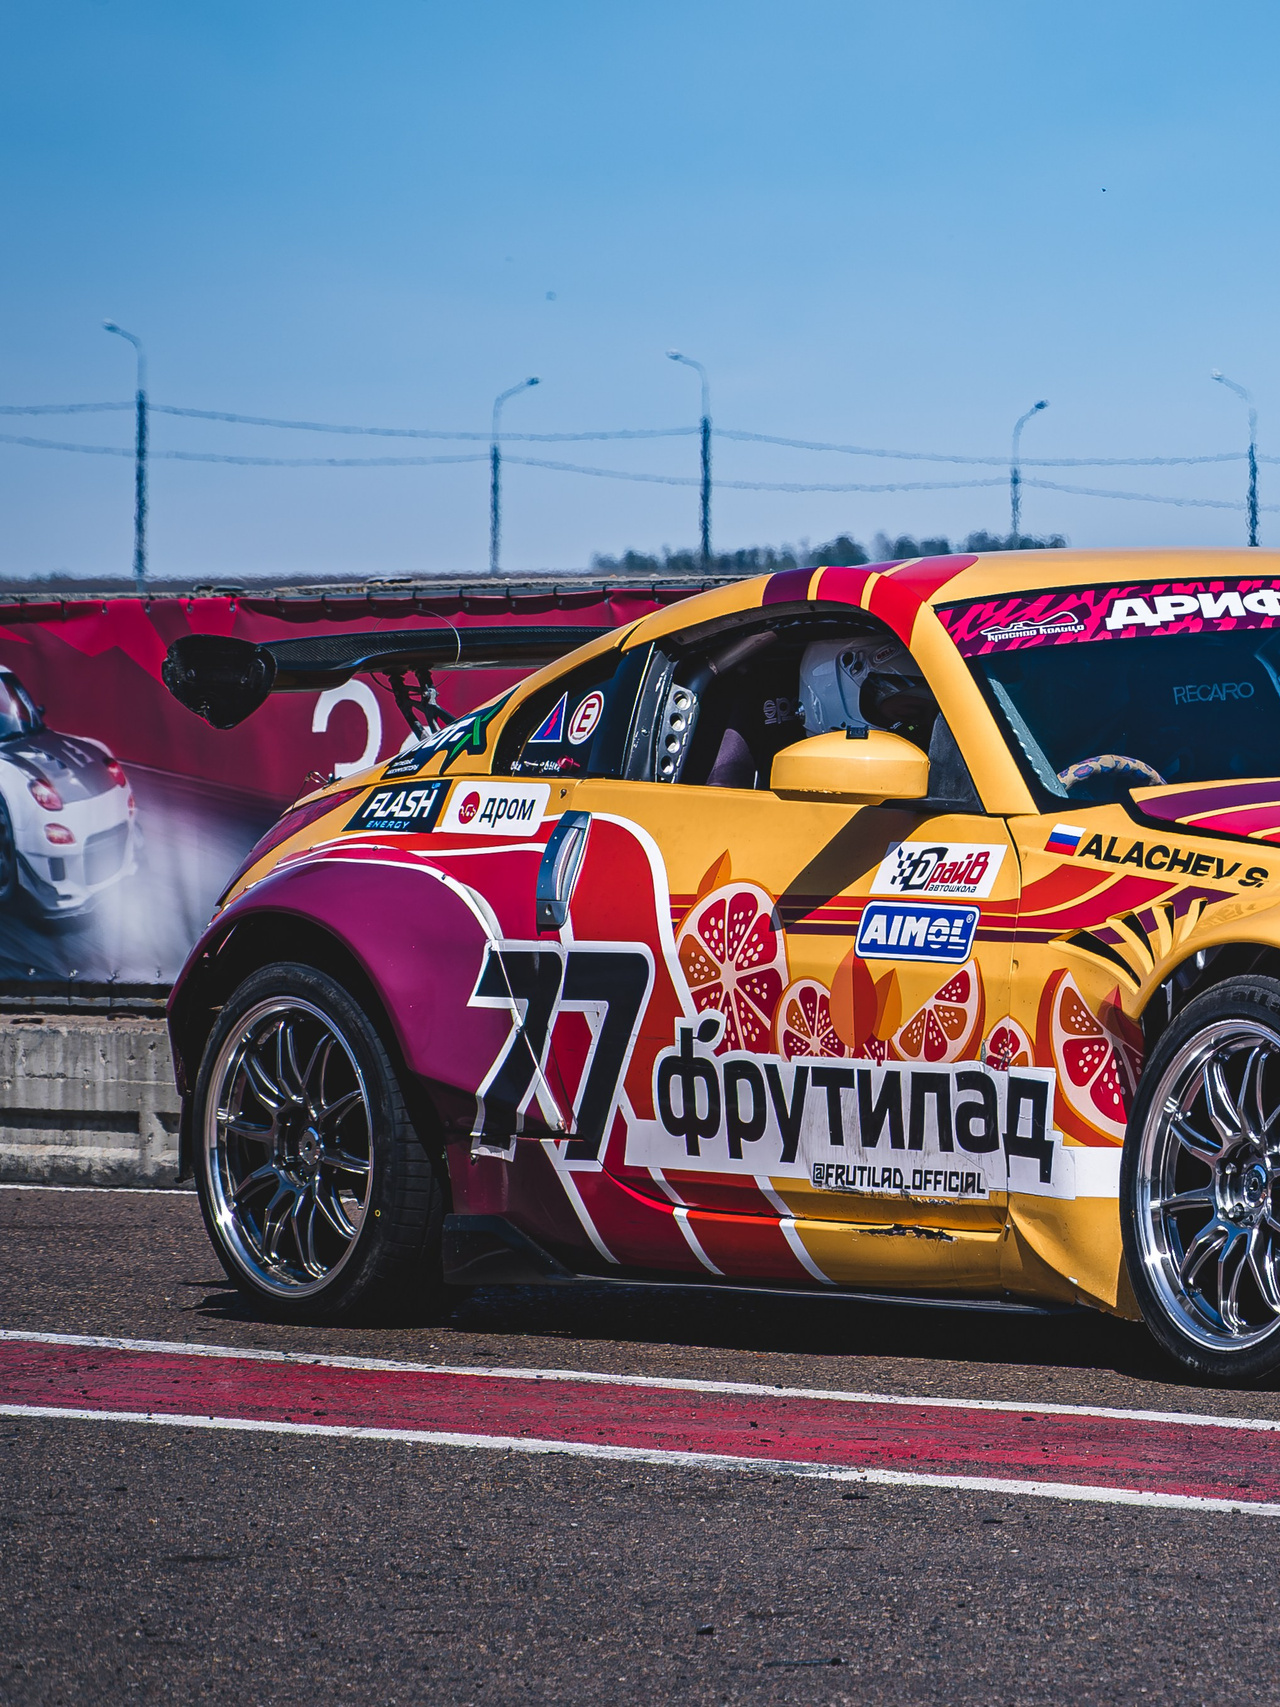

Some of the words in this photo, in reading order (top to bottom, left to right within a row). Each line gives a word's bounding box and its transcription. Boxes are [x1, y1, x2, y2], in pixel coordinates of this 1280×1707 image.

[1172, 682, 1255, 705] RECARO
[575, 702, 597, 733] E
[362, 789, 439, 818] FLASH
[366, 820, 410, 829] ENERGY
[1077, 833, 1242, 879] ALACHEV
[470, 940, 654, 1168] 77
[813, 1162, 986, 1194] @FRUTILAD_OFFICIAL
